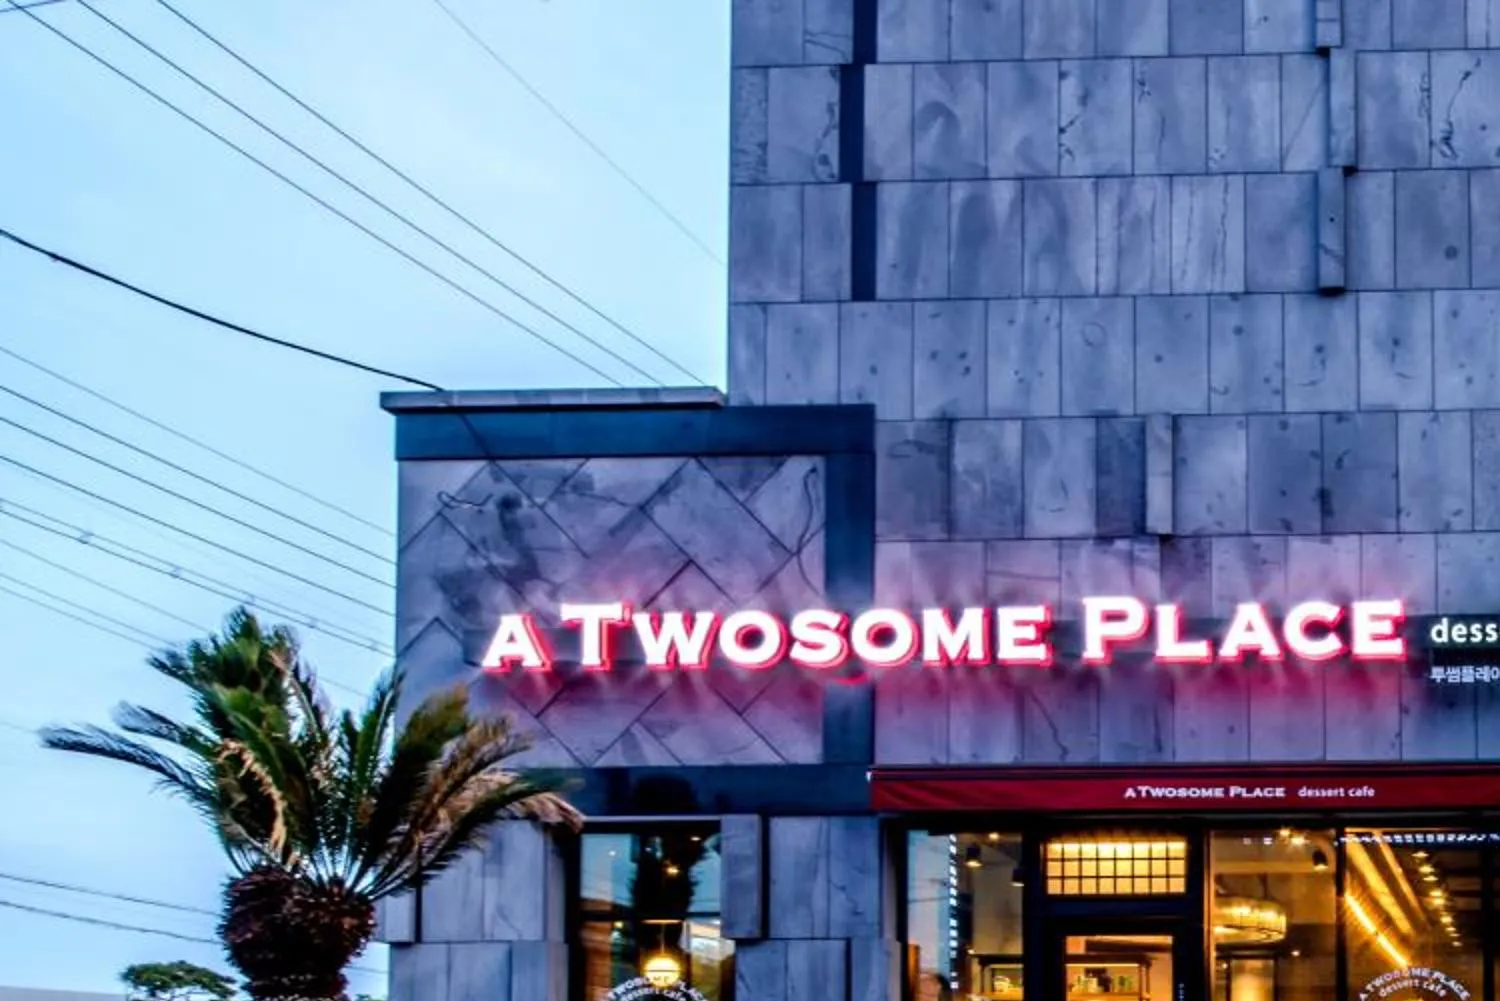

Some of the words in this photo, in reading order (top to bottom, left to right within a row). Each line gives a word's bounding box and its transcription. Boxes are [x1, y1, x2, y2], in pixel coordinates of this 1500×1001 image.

[482, 612, 552, 672] A
[559, 601, 1052, 672] TWOSOME
[1081, 595, 1408, 665] PLACE
[1124, 787, 1136, 798] A
[1136, 785, 1225, 798] TWOSOME
[1228, 785, 1287, 798] PLACE
[1297, 786, 1346, 798] dessert
[1347, 786, 1376, 798] cafe
